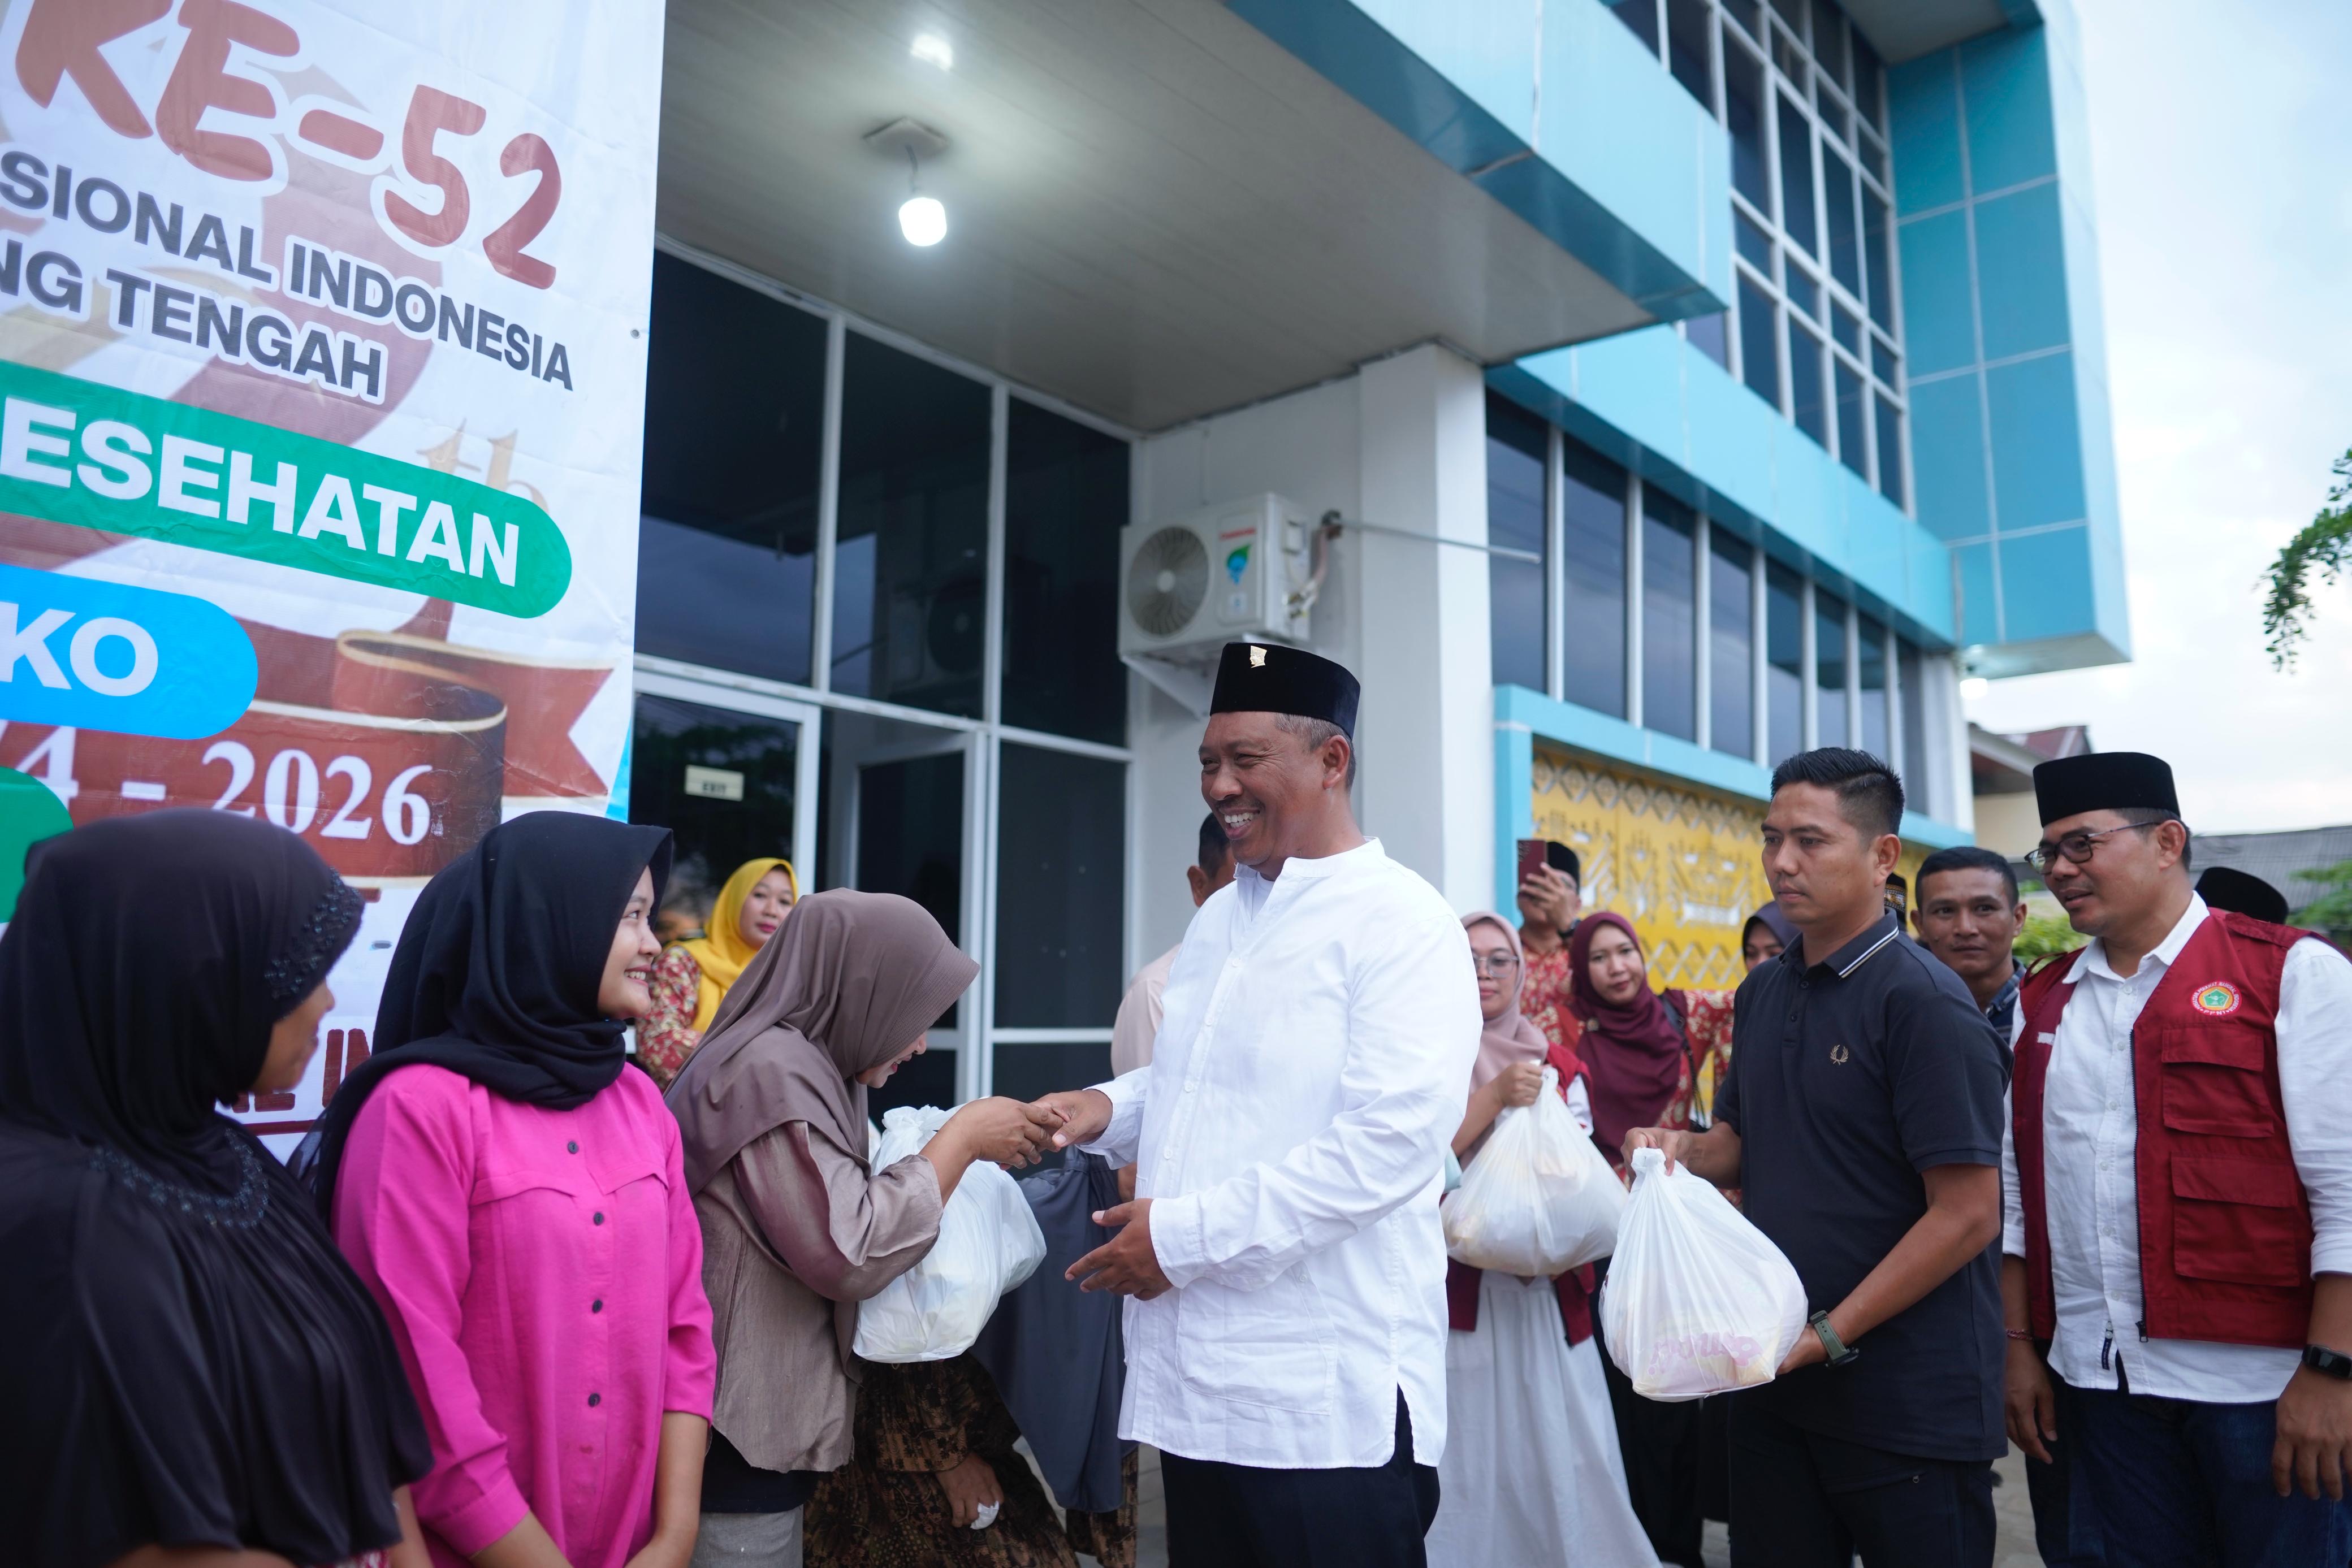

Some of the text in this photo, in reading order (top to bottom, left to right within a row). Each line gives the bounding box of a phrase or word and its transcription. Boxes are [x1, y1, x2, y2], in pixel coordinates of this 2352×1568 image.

[15, 0, 561, 289] KE-52
[0, 150, 573, 391] SIONAL INDONESIA
[106, 268, 381, 397] TENGAH
[0, 396, 519, 587] ESEHATAN
[0, 601, 158, 696] KO
[202, 740, 433, 845] 2026
